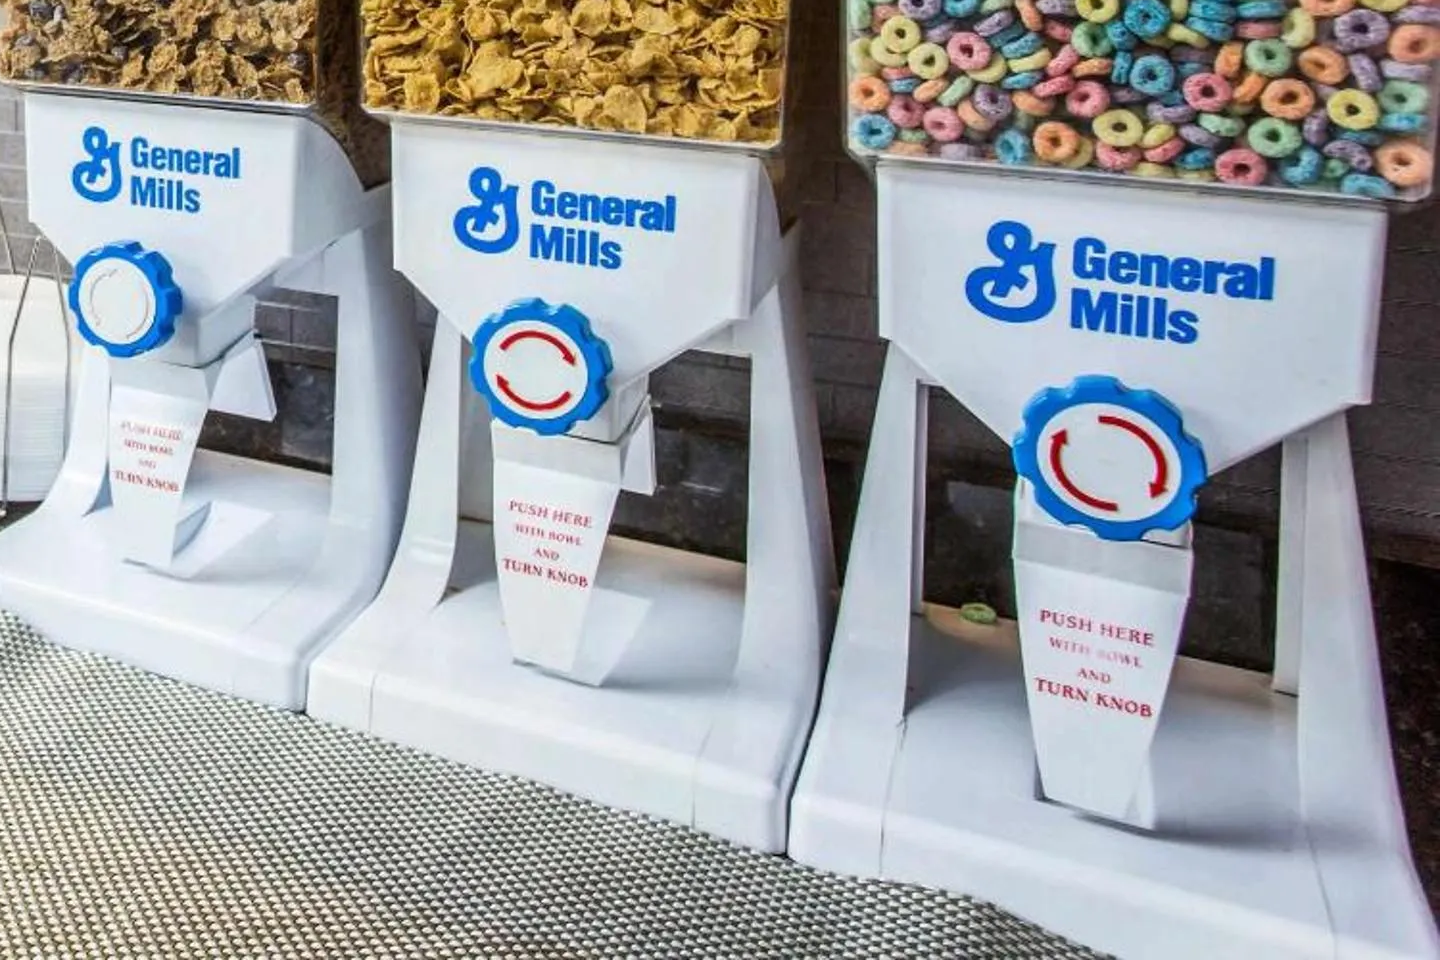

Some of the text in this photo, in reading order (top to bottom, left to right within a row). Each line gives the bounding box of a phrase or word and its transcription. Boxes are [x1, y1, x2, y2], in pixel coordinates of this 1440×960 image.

[131, 136, 241, 179] General
[131, 175, 201, 214] Mills
[531, 180, 677, 232] General
[530, 224, 623, 270] Mills
[1072, 237, 1275, 300] General
[1070, 287, 1199, 344] Mills
[508, 500, 592, 528] PUSH HERE
[515, 524, 582, 546] WITH BOWL
[534, 547, 560, 561] AND
[503, 558, 588, 588] TURN KNOB
[1040, 609, 1155, 648] PUSH HERE
[1049, 637, 1090, 655] WITH
[1077, 667, 1111, 685] AND
[1034, 677, 1152, 718] TURN KNOB
